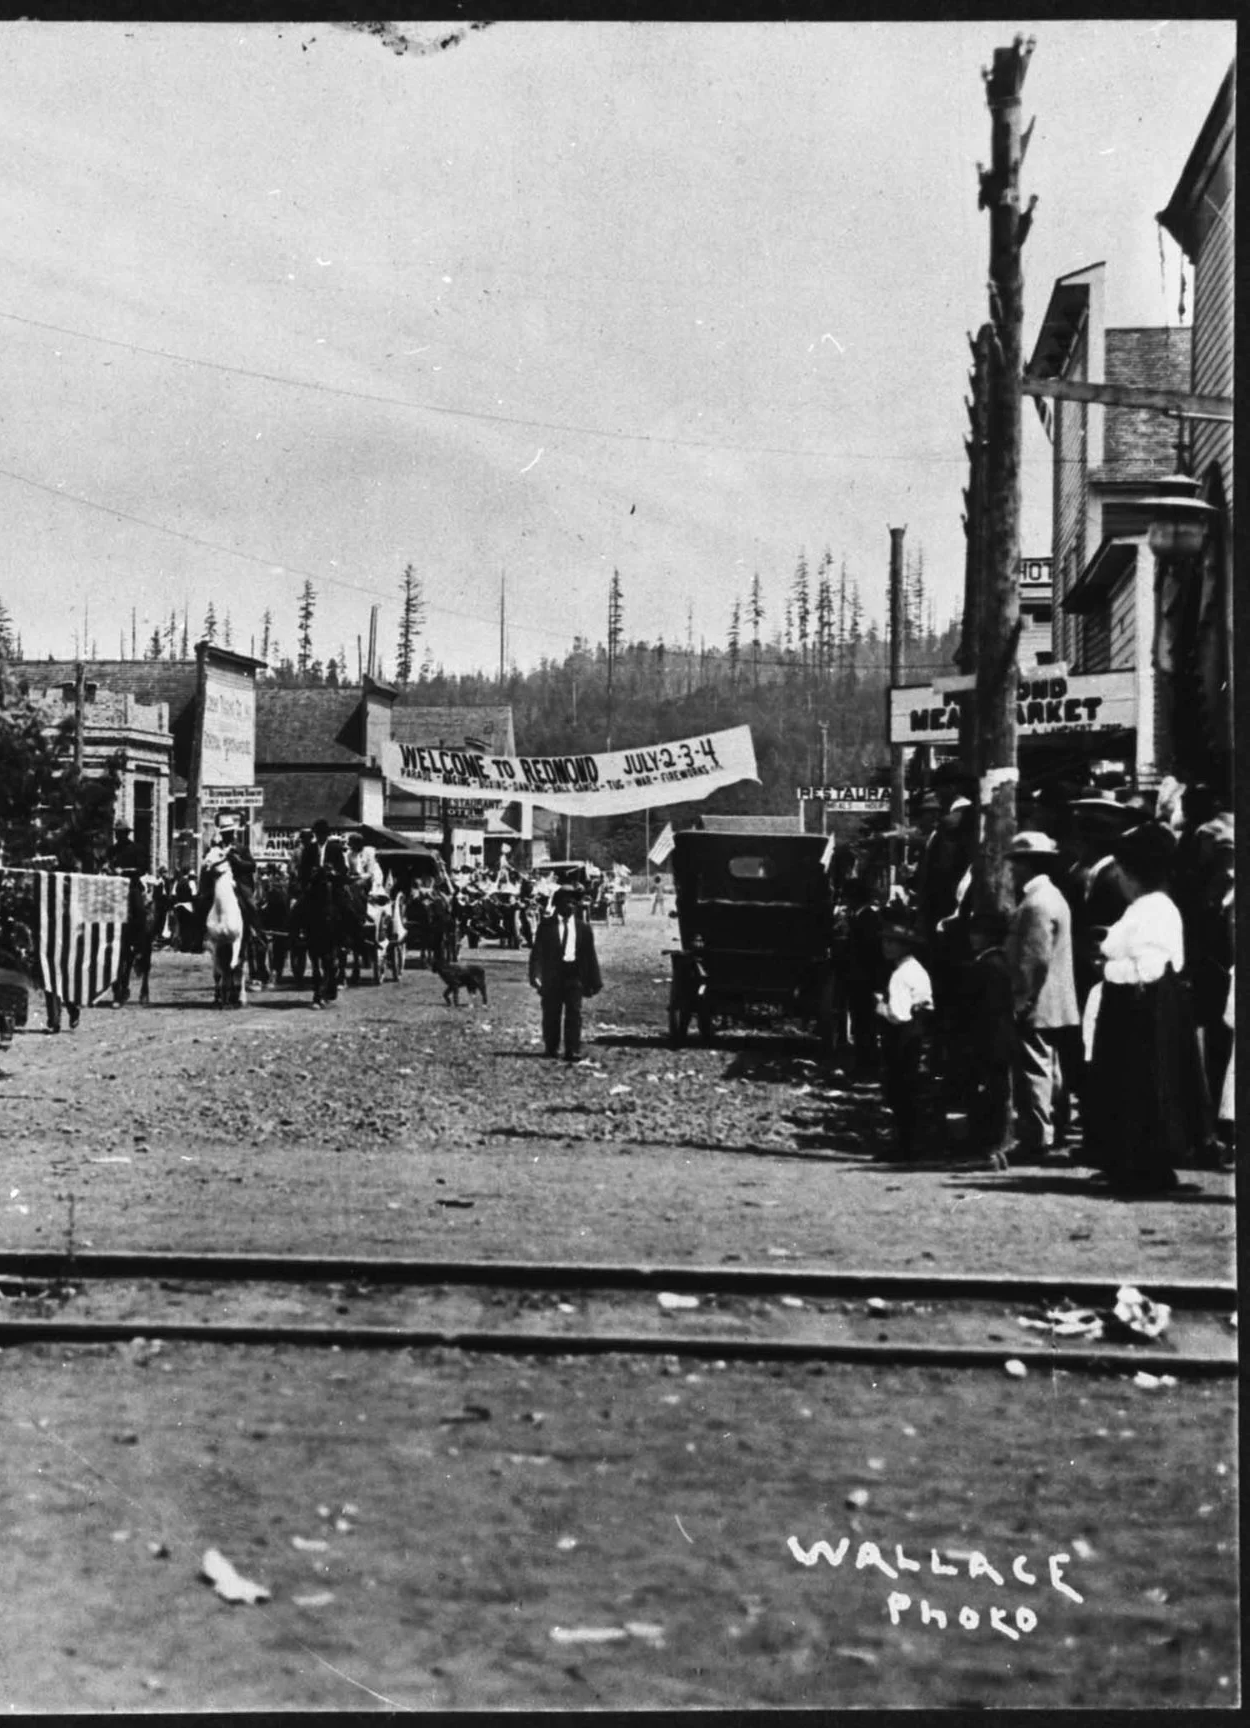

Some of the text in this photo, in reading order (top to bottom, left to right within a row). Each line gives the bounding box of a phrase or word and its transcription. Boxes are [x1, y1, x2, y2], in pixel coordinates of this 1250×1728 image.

[910, 705, 960, 731] MEA
[400, 744, 490, 779] WELCOME
[491, 759, 515, 779] TO
[518, 756, 599, 785] REDMOND
[800, 786, 892, 800] RESTAURA
